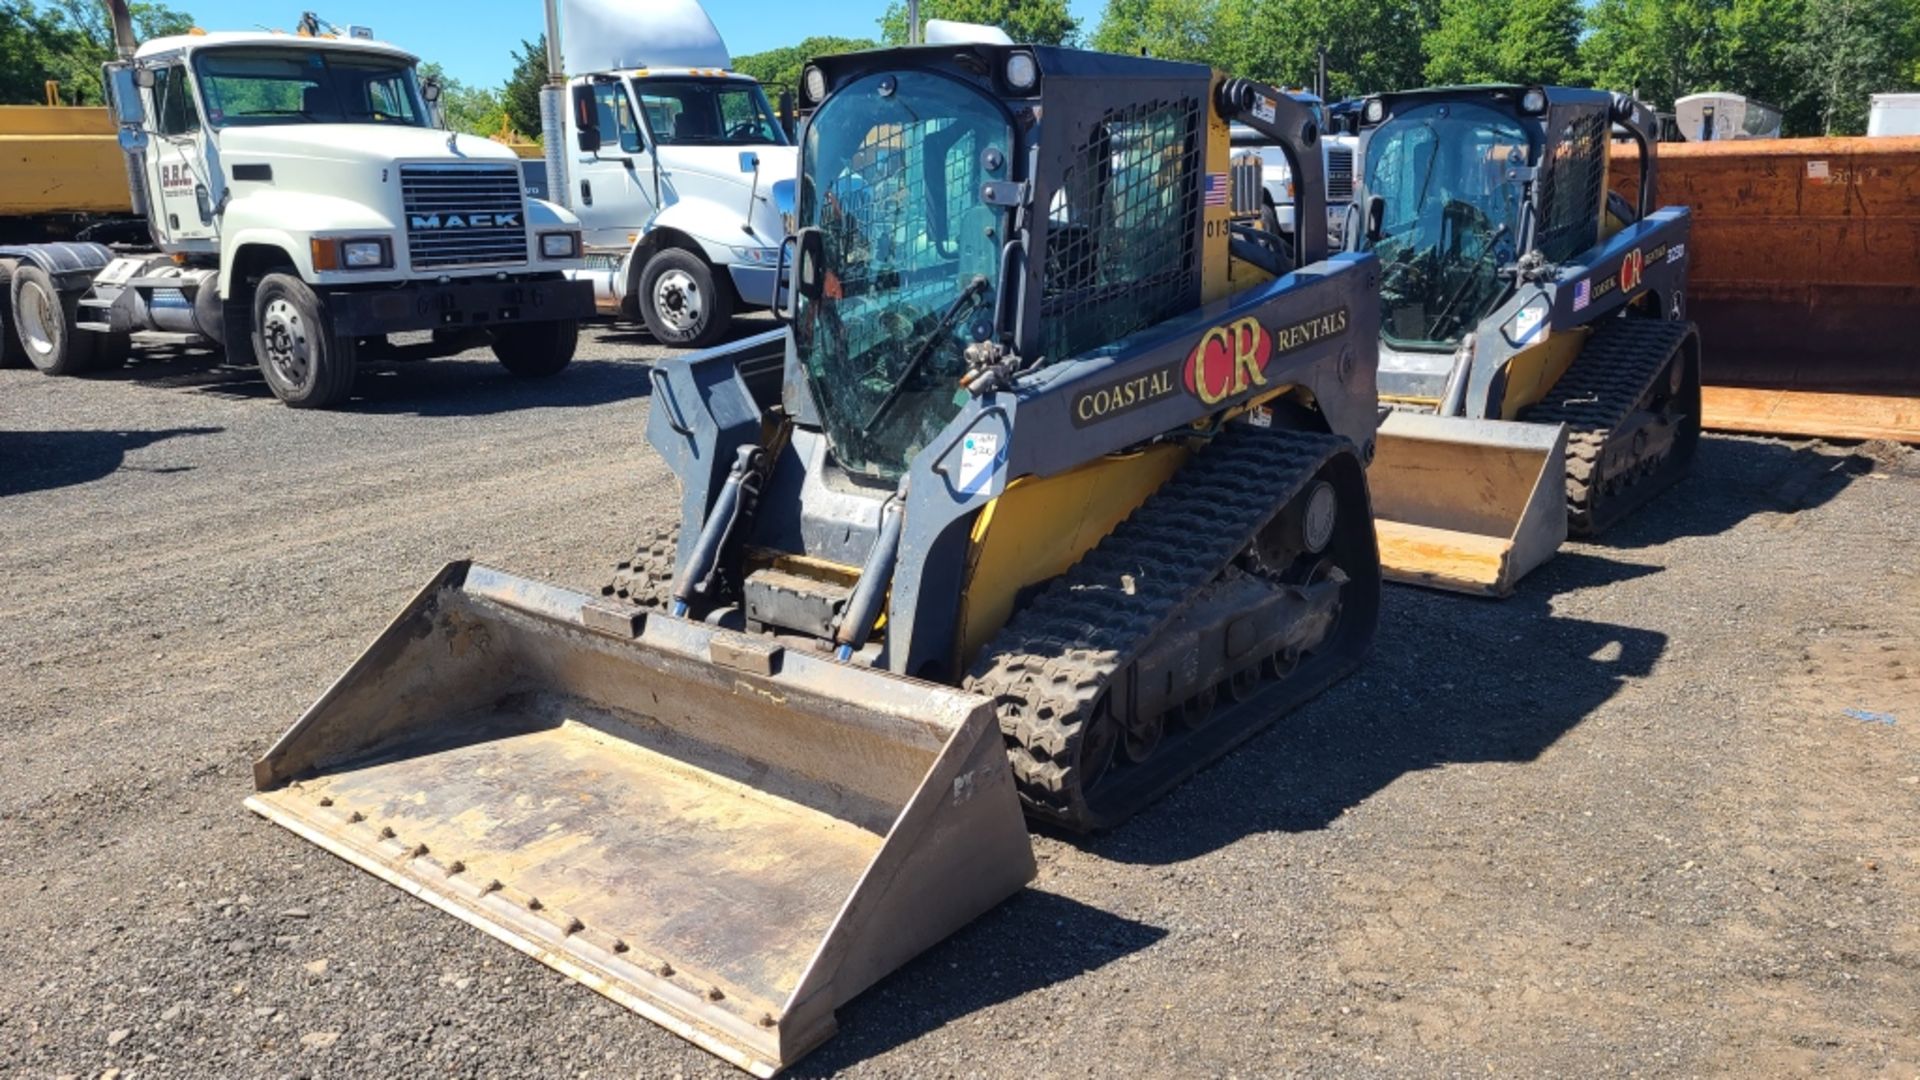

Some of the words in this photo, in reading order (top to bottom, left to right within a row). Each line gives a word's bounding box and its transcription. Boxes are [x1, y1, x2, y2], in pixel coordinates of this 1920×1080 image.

[411, 213, 519, 229] MACK
[1621, 248, 1641, 293] CR
[1078, 370, 1173, 421] COASTAL
[1195, 316, 1267, 405] CR
[1278, 310, 1346, 351] RENTALS
